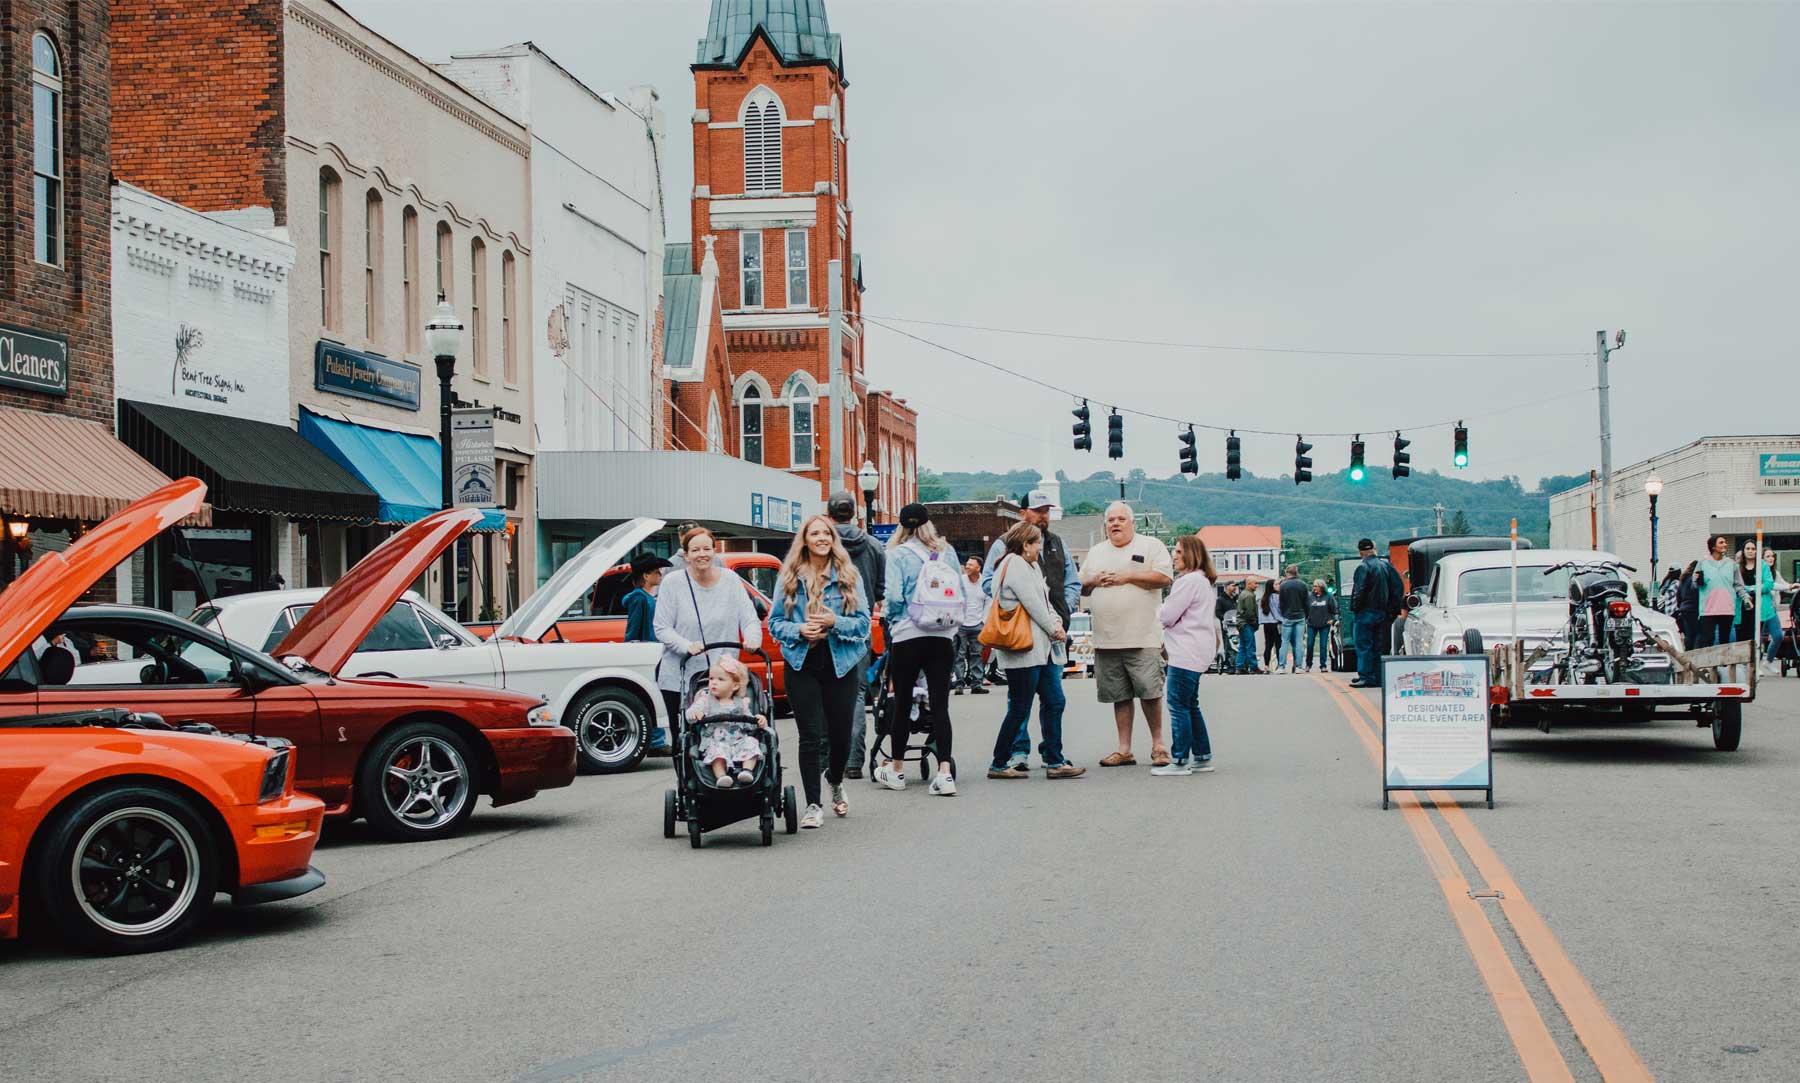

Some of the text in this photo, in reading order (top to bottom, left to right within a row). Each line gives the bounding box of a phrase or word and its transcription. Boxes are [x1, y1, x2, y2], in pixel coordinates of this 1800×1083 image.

[0, 336, 60, 382] Cleaners
[181, 367, 197, 384] Bent
[198, 371, 213, 386] Tree
[326, 354, 351, 377] Pulaski
[350, 362, 375, 389] Jewelry
[455, 439, 493, 449] Historic
[1407, 704, 1465, 713] DESIGNATED
[1390, 713, 1486, 722] SPECIAL EVENT AREA
